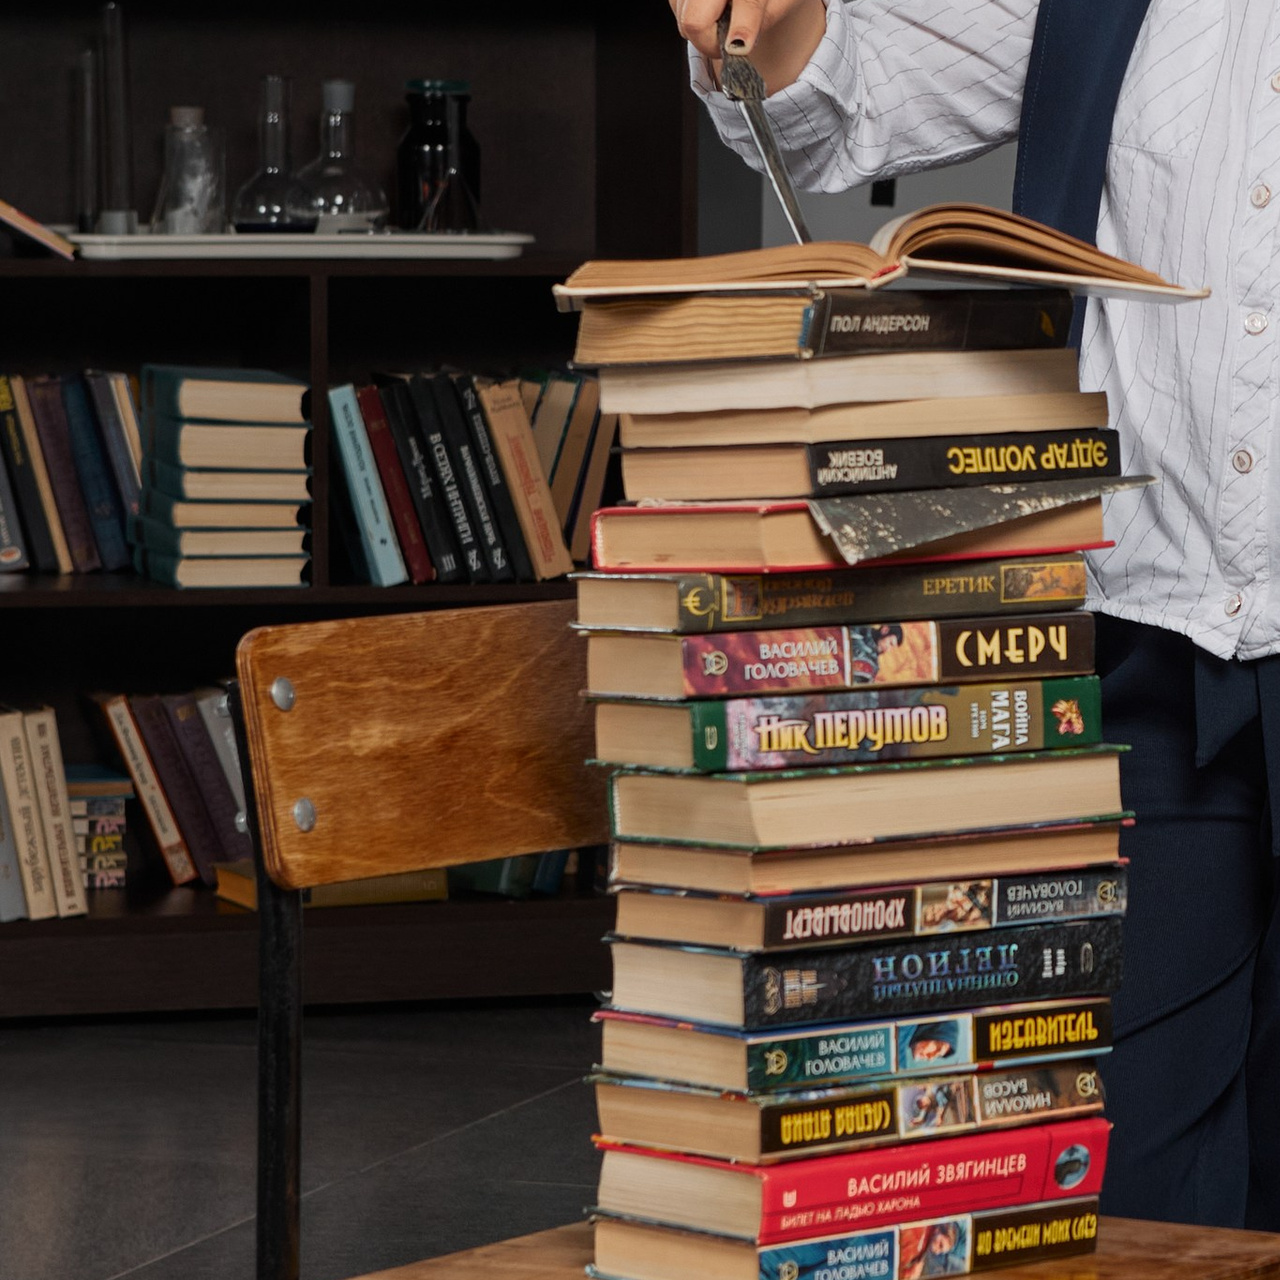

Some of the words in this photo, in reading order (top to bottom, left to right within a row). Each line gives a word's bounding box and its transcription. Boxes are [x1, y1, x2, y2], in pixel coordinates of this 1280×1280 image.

[830, 315, 862, 332] ПОЛ
[862, 315, 931, 334] АНДЕРСОН
[828, 448, 884, 469] БОЕВИК
[946, 444, 1037, 475] УОЛЛЕС
[1040, 438, 1109, 470] ЭДГАР
[817, 463, 898, 487] АНГЛИЙСКИЙ
[922, 574, 997, 597] ЕРЕТИК
[760, 636, 839, 661] ВАСИЛИЙ
[955, 625, 1069, 667] СМЕРЧ
[744, 659, 840, 682] ГОЛОВАЧЕВ
[991, 690, 1011, 750] МАГА
[1013, 690, 1031, 746] ВОЙНА
[1006, 879, 1084, 902] ГОЛОВАЧЕВ
[782, 898, 906, 941] ХРОНОВЫВЕРТ
[1006, 898, 1065, 919] ВАСИЛИЙ
[871, 943, 1019, 983] ЛЕГИОН
[818, 1030, 886, 1056] ВАСИЛИЙ
[989, 1010, 1099, 1053] ИЗБАВИТЕЛЬ
[805, 1052, 887, 1077] ГОЛОВАЧЕВ
[983, 1077, 1029, 1098] БАСОВ
[834, 1100, 892, 1137] СЛЕПАЯ
[985, 1092, 1052, 1117] НИКОЛАЙ
[780, 1109, 833, 1145] АТАКА
[847, 1165, 931, 1198] ВАСИЛИЙ
[935, 1153, 1028, 1186] ЗВЯГИНЦЕВ
[781, 1212, 814, 1230] БИЛЕТ
[815, 1209, 832, 1223] НА
[834, 1202, 875, 1221] ЛАДЬЮ
[876, 1195, 921, 1215] ХАРОНА
[993, 1223, 1040, 1253] ВРЕМЕНИ
[1041, 1218, 1072, 1245] МОИХ
[827, 1238, 889, 1267] ВАСИЛИЙ
